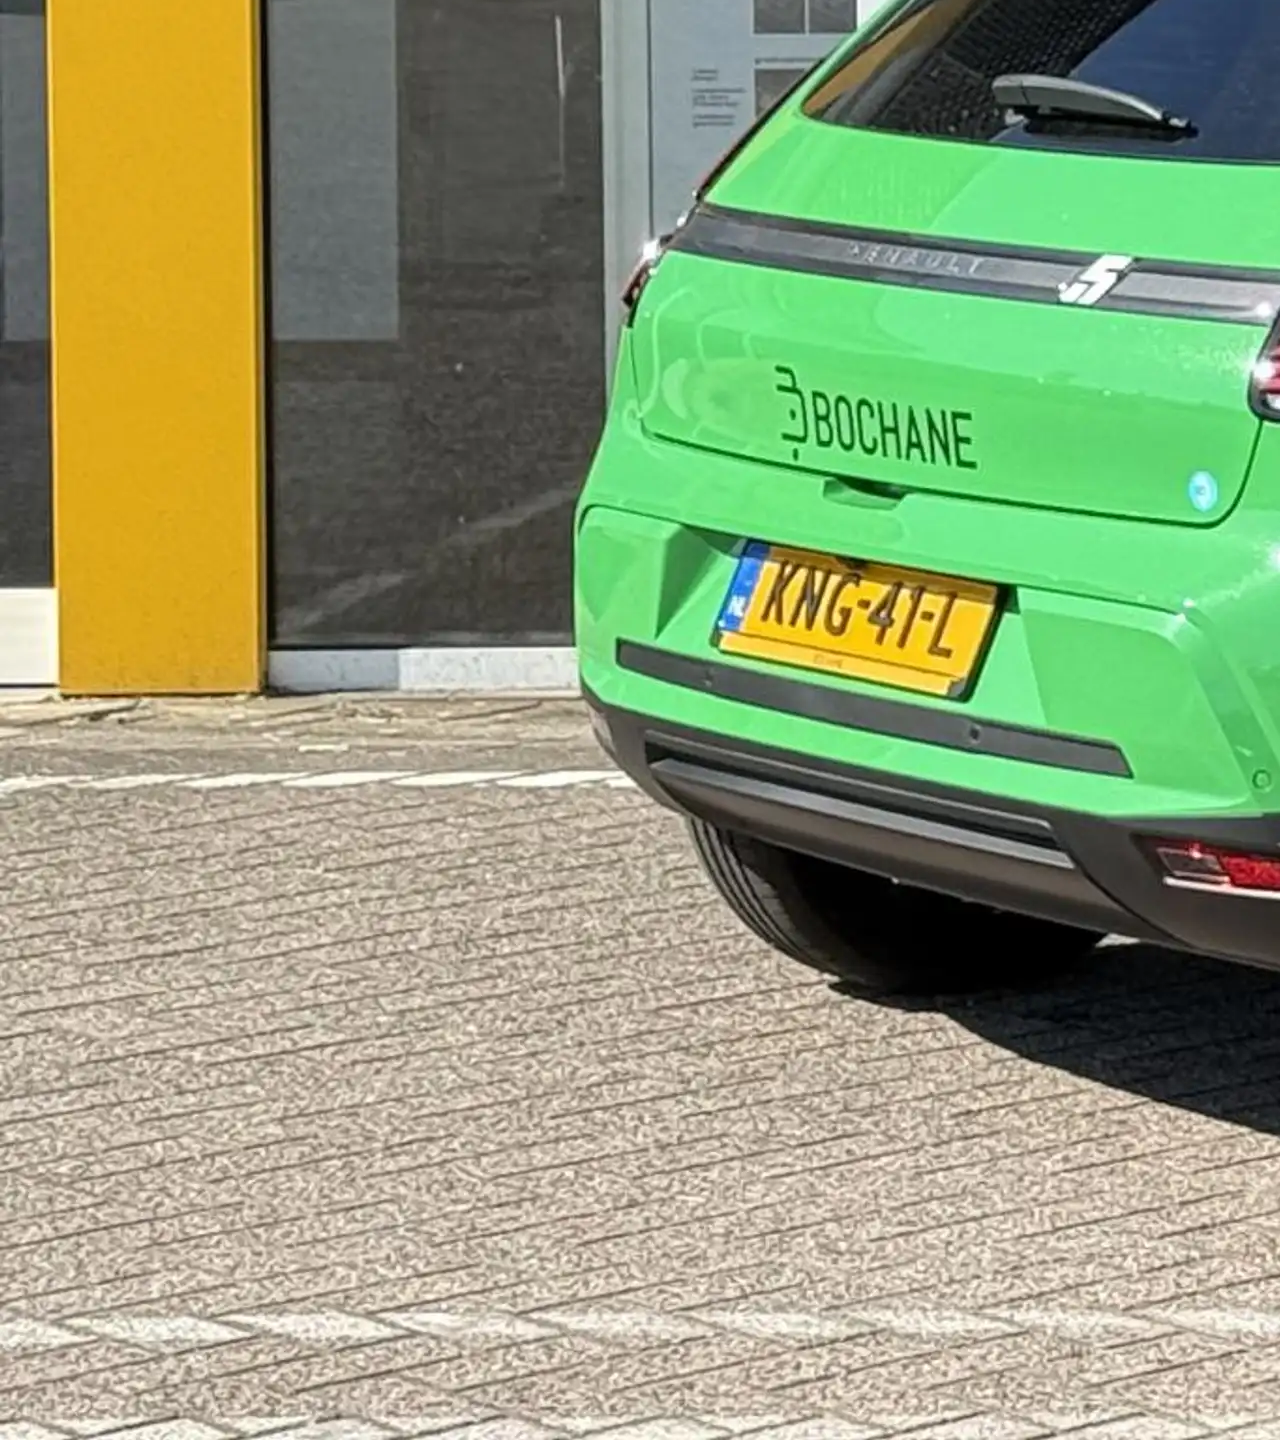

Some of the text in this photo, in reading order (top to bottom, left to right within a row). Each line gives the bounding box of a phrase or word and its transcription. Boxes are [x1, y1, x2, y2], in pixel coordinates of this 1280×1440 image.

[846, 241, 987, 276] RENAULT
[814, 388, 978, 469] BOCHANE
[760, 559, 958, 660] KNG-41-L
